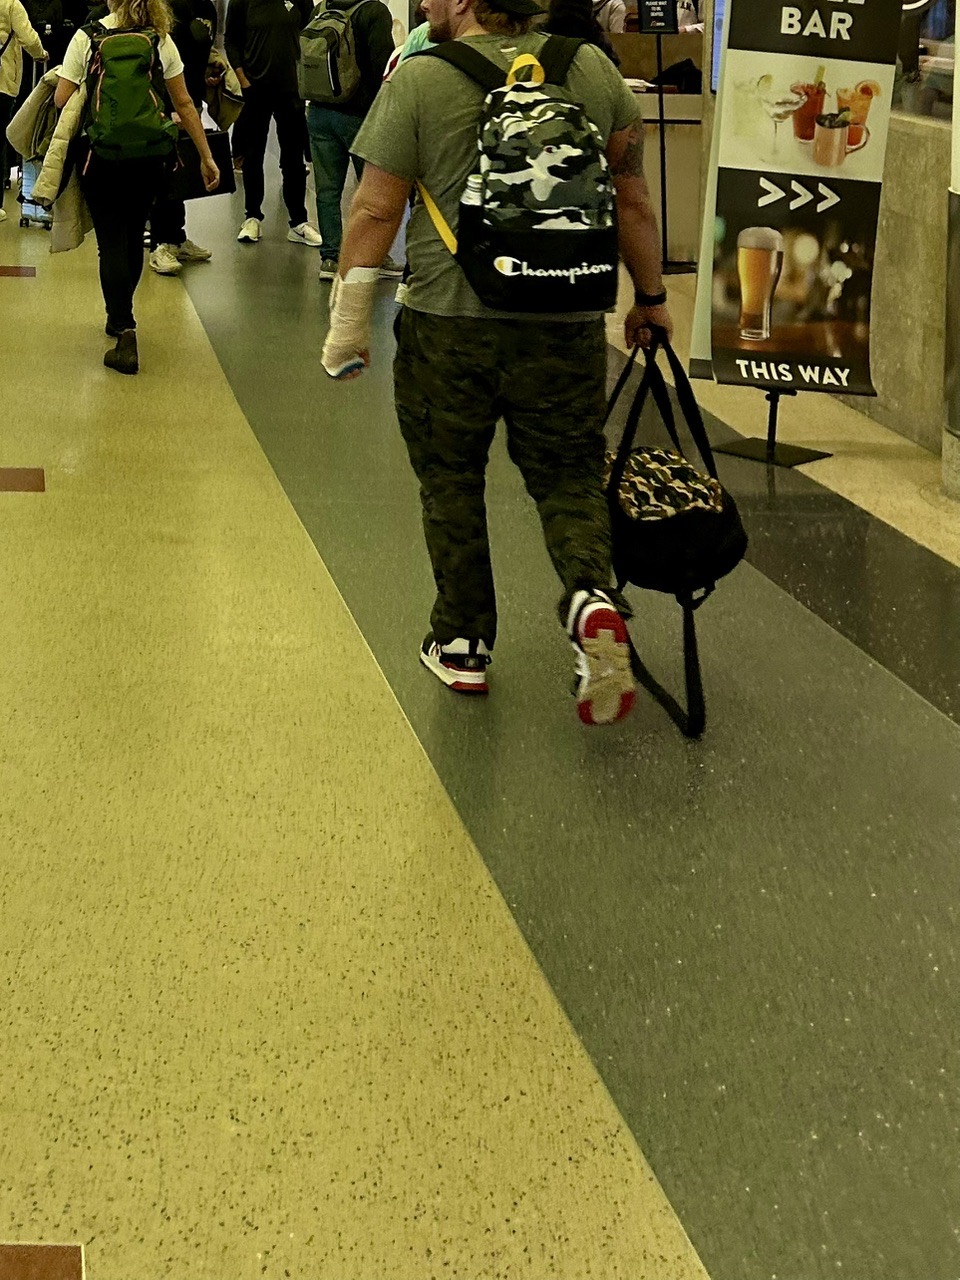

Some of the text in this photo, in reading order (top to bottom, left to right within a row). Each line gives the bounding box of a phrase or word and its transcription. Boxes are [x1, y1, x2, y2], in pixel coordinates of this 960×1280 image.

[780, 7, 853, 40] BAR
[493, 256, 614, 284] Champion
[736, 359, 851, 387] THIS WAY
